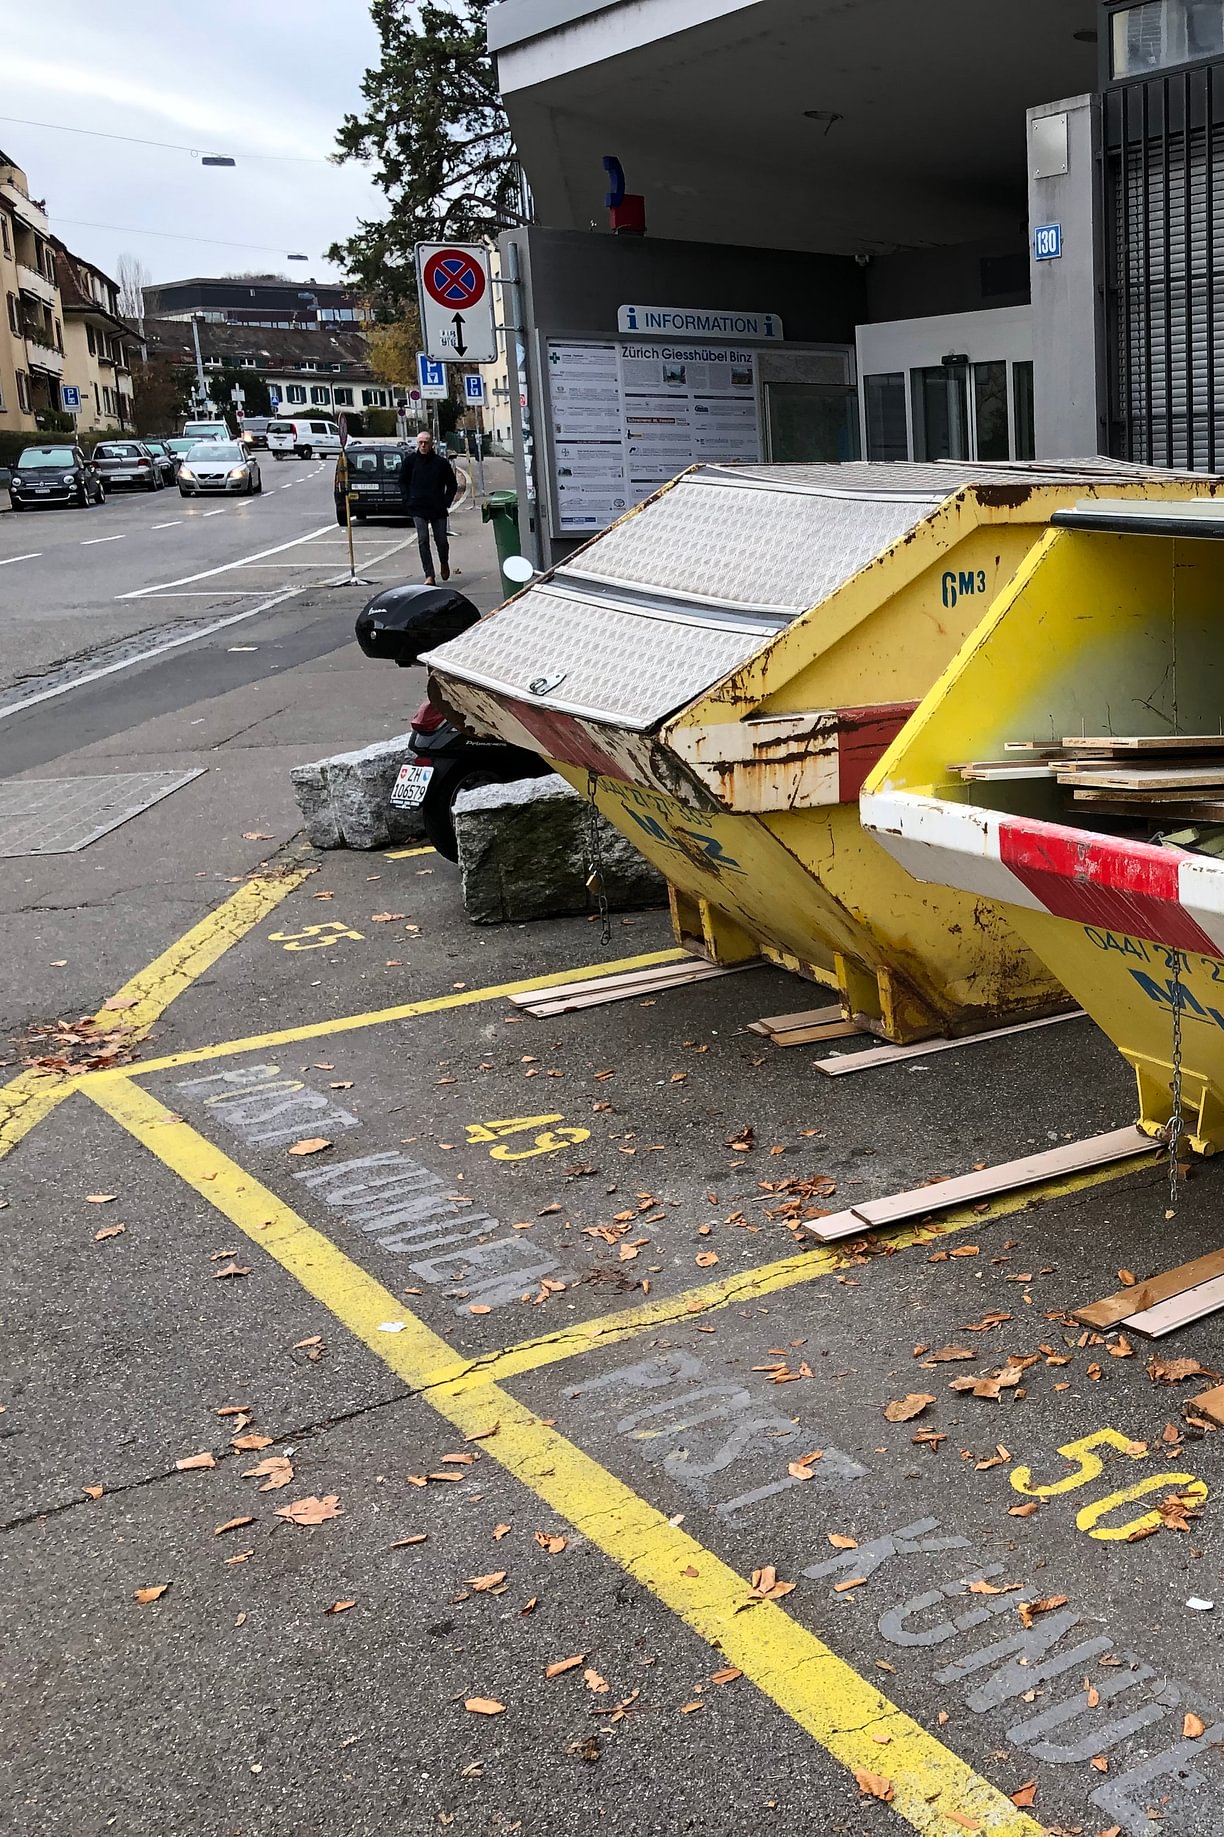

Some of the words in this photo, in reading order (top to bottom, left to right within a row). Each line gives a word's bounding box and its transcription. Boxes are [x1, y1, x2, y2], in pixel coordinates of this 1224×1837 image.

[1037, 229, 1057, 254] 130
[645, 312, 758, 333] INFORMATION
[621, 346, 660, 360] Zürich
[661, 347, 728, 363] Giesshübel
[729, 351, 753, 363] Binz
[407, 767, 423, 782] ZH
[392, 783, 426, 801] 106579
[267, 921, 366, 952] 55
[463, 1113, 592, 1162] 49
[175, 1064, 364, 1147] POST
[292, 1150, 579, 1316] KUNDEN
[561, 1351, 870, 1521] POST
[1009, 1427, 1210, 1542] 50
